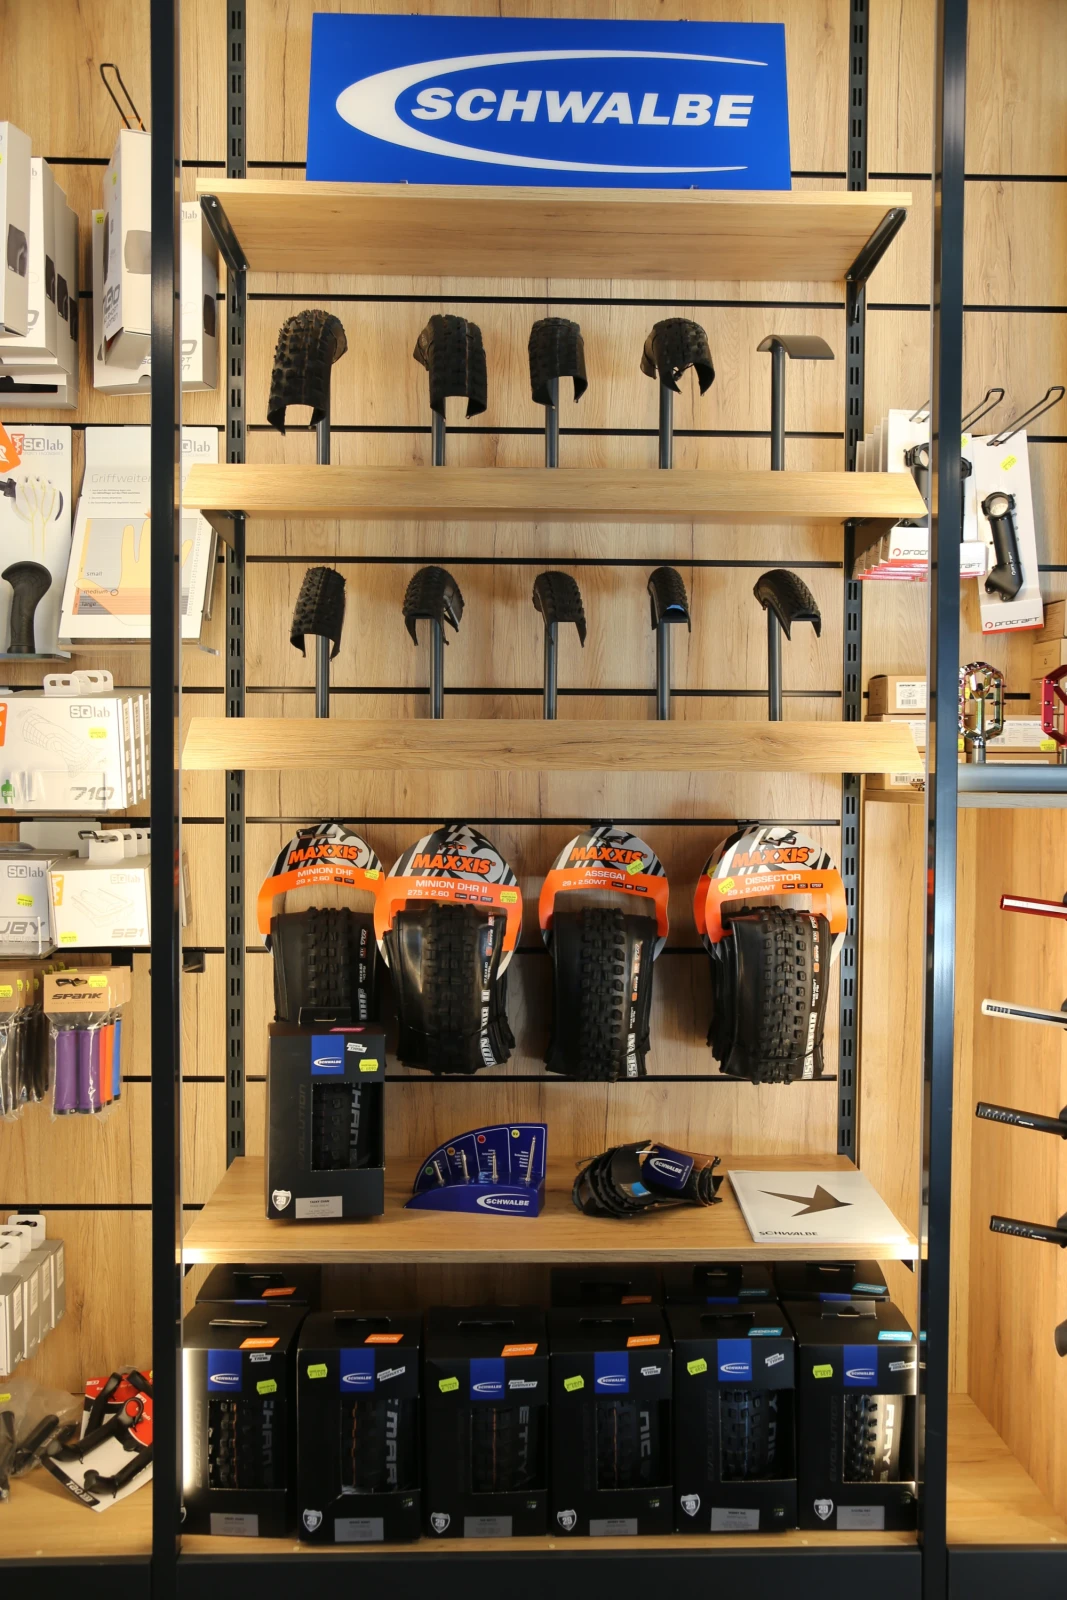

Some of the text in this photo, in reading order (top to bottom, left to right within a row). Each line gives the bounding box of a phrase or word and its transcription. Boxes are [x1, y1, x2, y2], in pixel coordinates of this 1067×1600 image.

[411, 87, 754, 128] SCHWALBE
[22, 438, 64, 452] SQlab
[181, 439, 211, 453] Qlab
[70, 704, 110, 719] SQlab
[70, 786, 115, 801] 710
[288, 843, 359, 866] MAXXIS
[569, 846, 644, 864] MAXXIS
[731, 847, 810, 869] MAXXIS
[411, 853, 492, 875] MAXXIS
[7, 864, 44, 879] SQlab
[297, 867, 354, 878] MINION DHF
[585, 870, 626, 881] ASSEGAI
[745, 873, 802, 885] DISSECTOR
[415, 879, 488, 894] MINION DHR II
[727, 889, 738, 897] 29
[654, 1159, 683, 1175] SCHWALBE
[275, 1195, 287, 1205] 29
[486, 1197, 530, 1207] SCHWALBE
[518, 1406, 530, 1475] ETTY
[882, 1403, 895, 1465] RAY
[386, 1410, 398, 1490] MAR
[685, 1501, 696, 1510] 29
[818, 1505, 829, 1513] 29
[307, 1516, 318, 1525] 29
[434, 1518, 445, 1527] 29
[562, 1516, 573, 1525] 29
